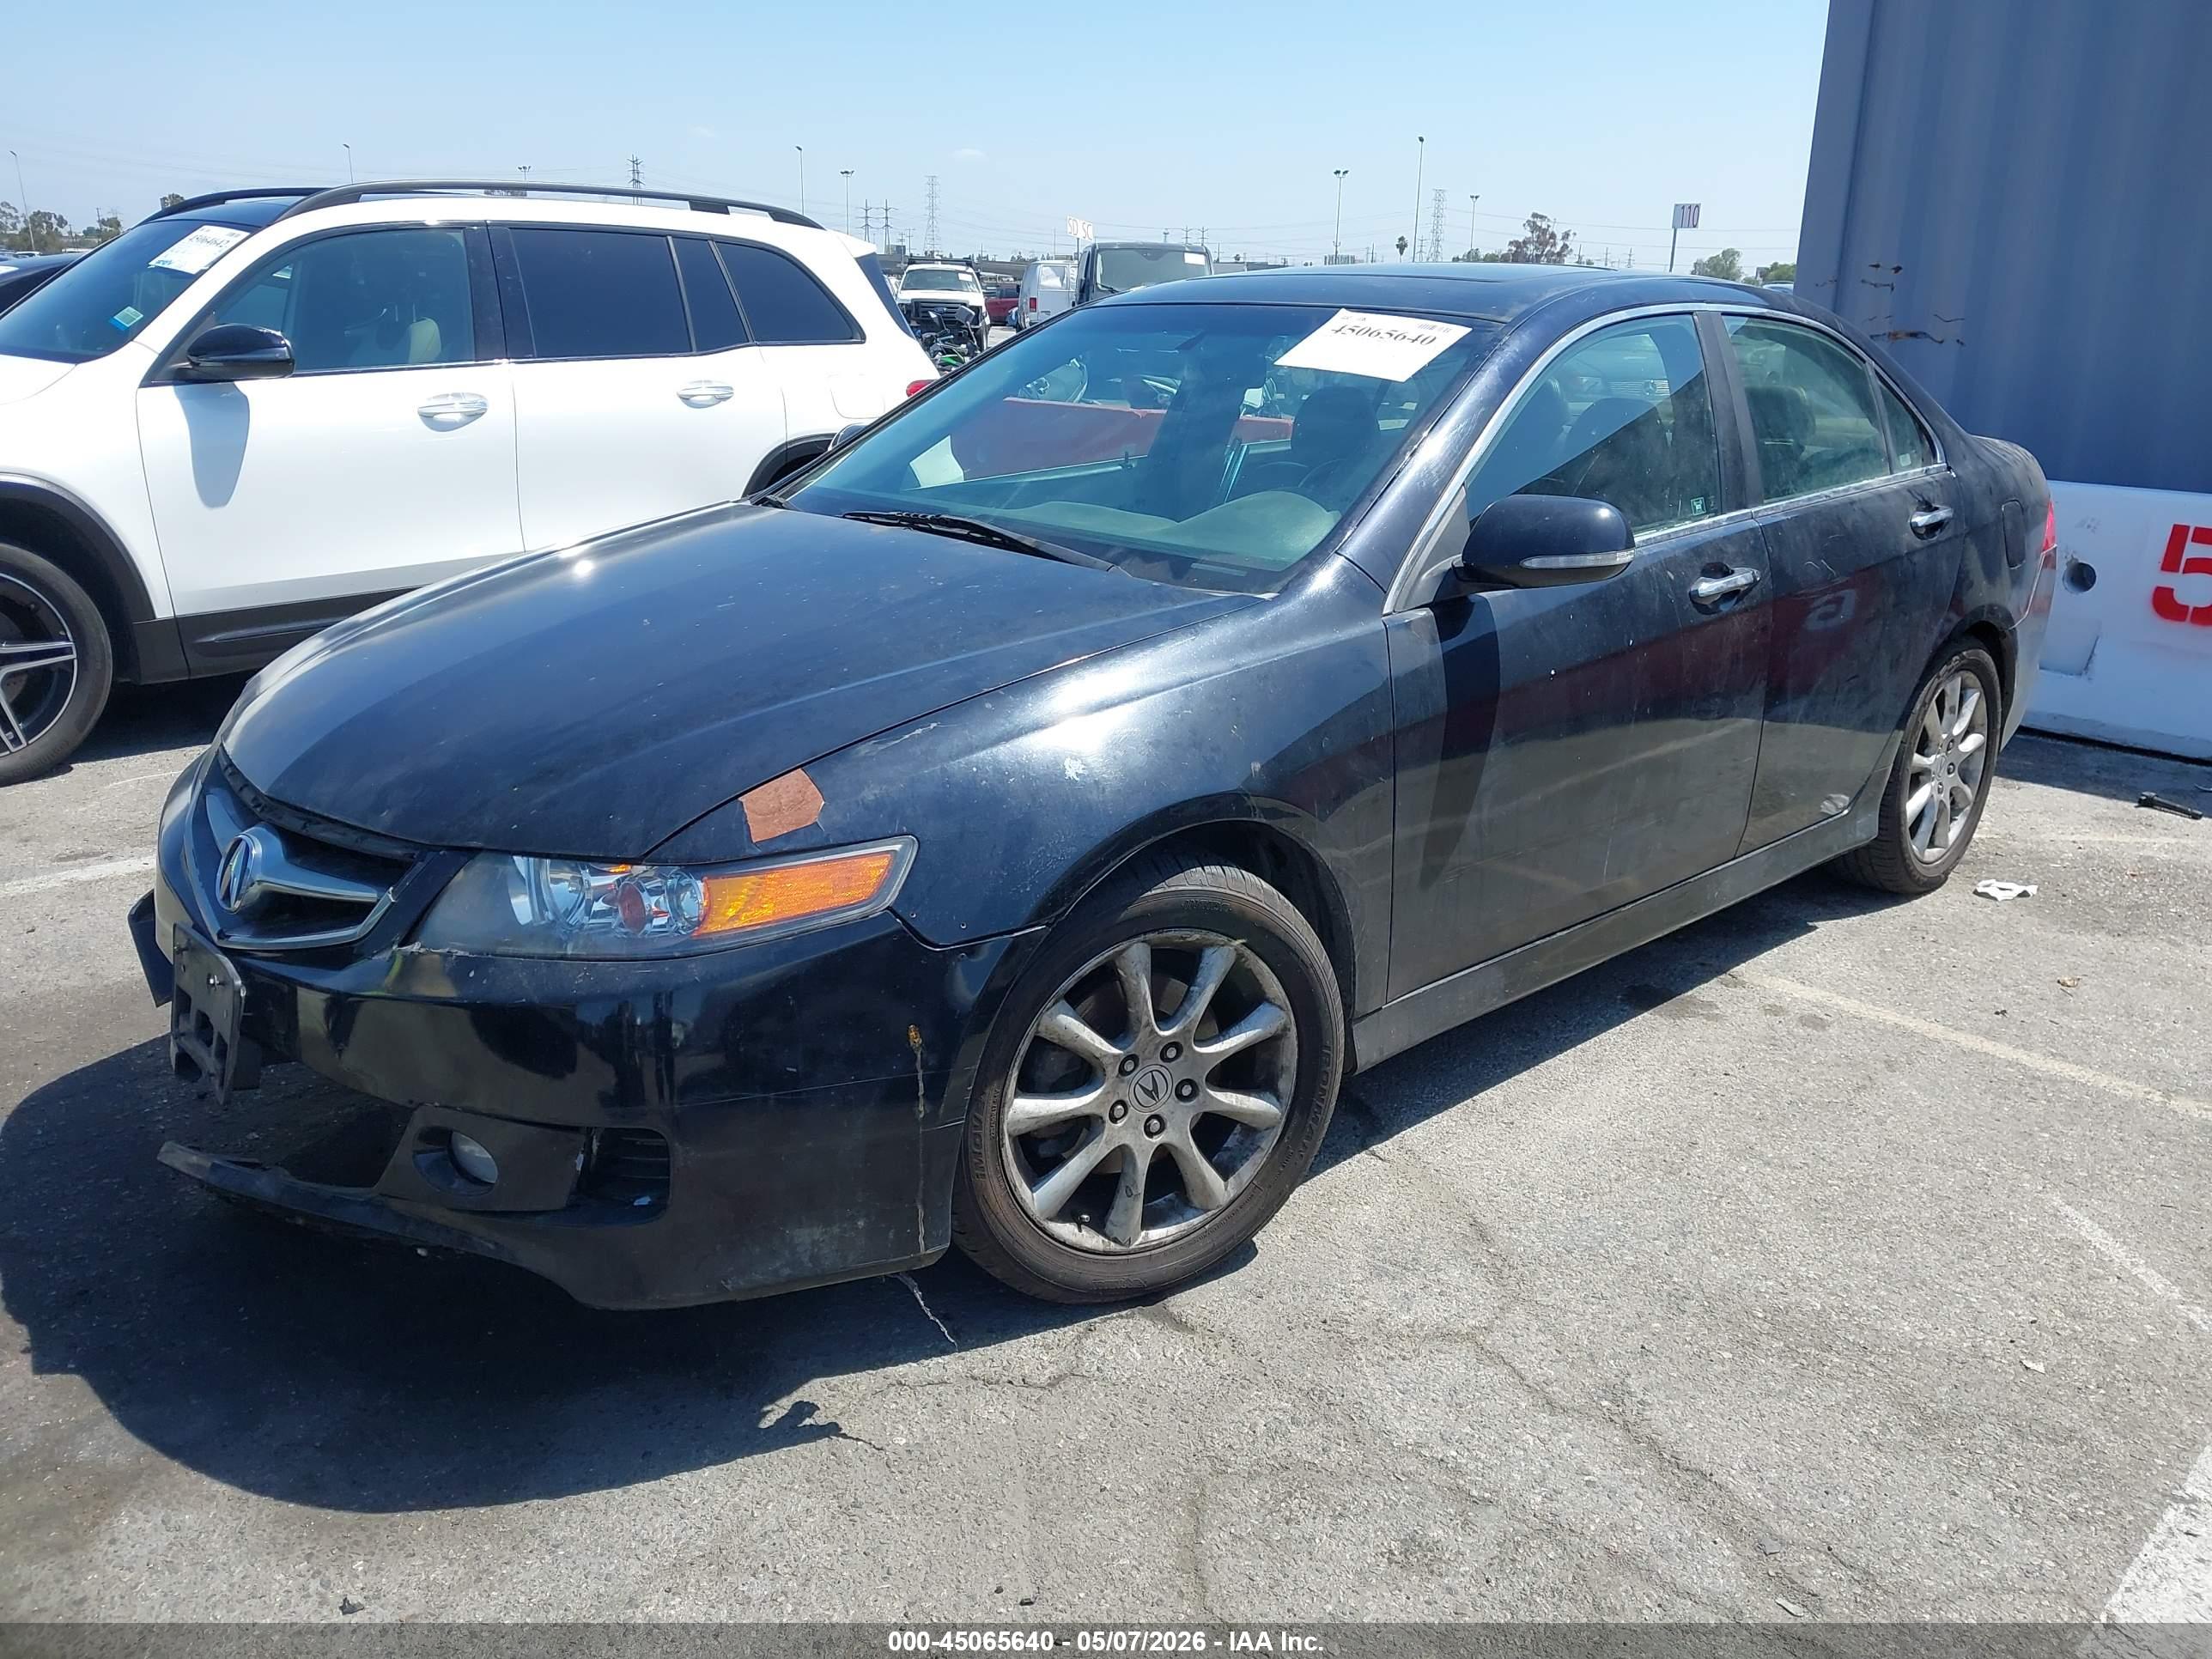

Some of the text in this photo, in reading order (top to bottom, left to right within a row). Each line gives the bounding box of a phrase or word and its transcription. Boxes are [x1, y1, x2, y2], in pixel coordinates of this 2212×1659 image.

[1680, 204, 1700, 228] 110
[1067, 217, 1092, 241] SD SC
[1331, 324, 1437, 346] 45065640
